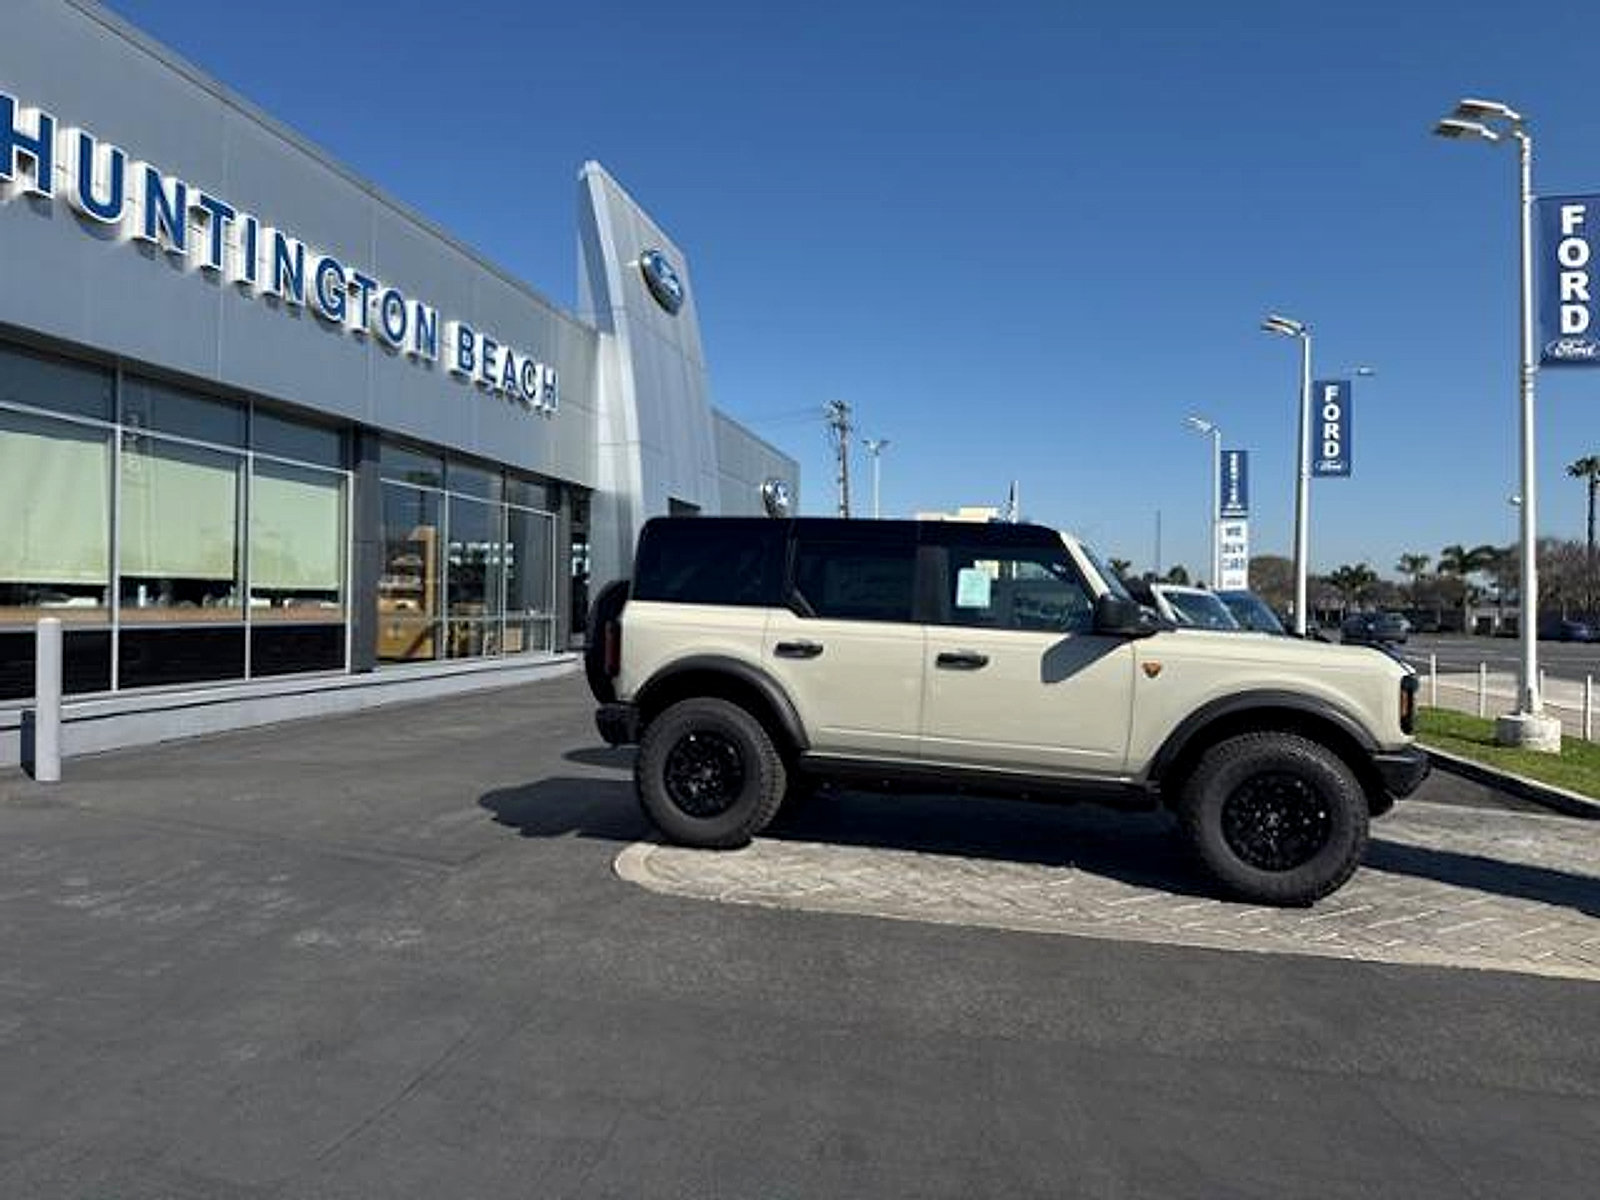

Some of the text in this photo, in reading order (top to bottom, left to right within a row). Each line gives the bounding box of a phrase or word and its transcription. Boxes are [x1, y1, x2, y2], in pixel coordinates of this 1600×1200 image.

[0, 90, 558, 411] HUNTINGTON BEACH
[1557, 204, 1591, 334] FORD
[1322, 385, 1341, 457] FORD
